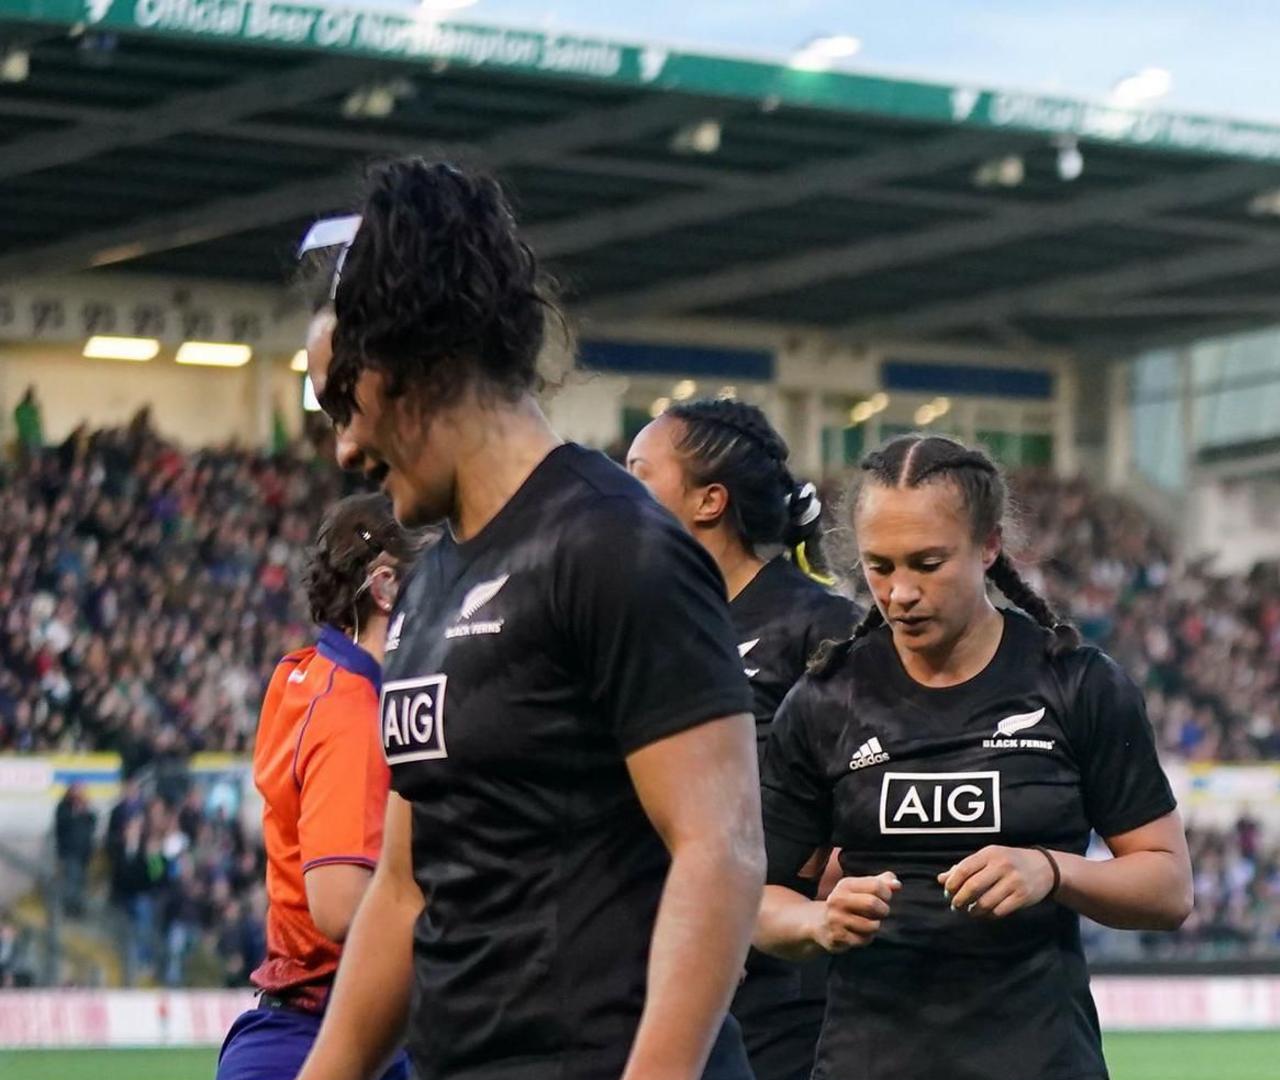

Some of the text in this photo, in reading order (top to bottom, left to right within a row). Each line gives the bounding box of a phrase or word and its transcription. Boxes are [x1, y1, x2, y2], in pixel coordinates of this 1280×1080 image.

[134, 0, 249, 35] Official
[384, 692, 434, 748] AIG
[849, 752, 890, 770] adidas
[982, 739, 1054, 750] BLACK FERNS
[893, 784, 986, 822] AIG
